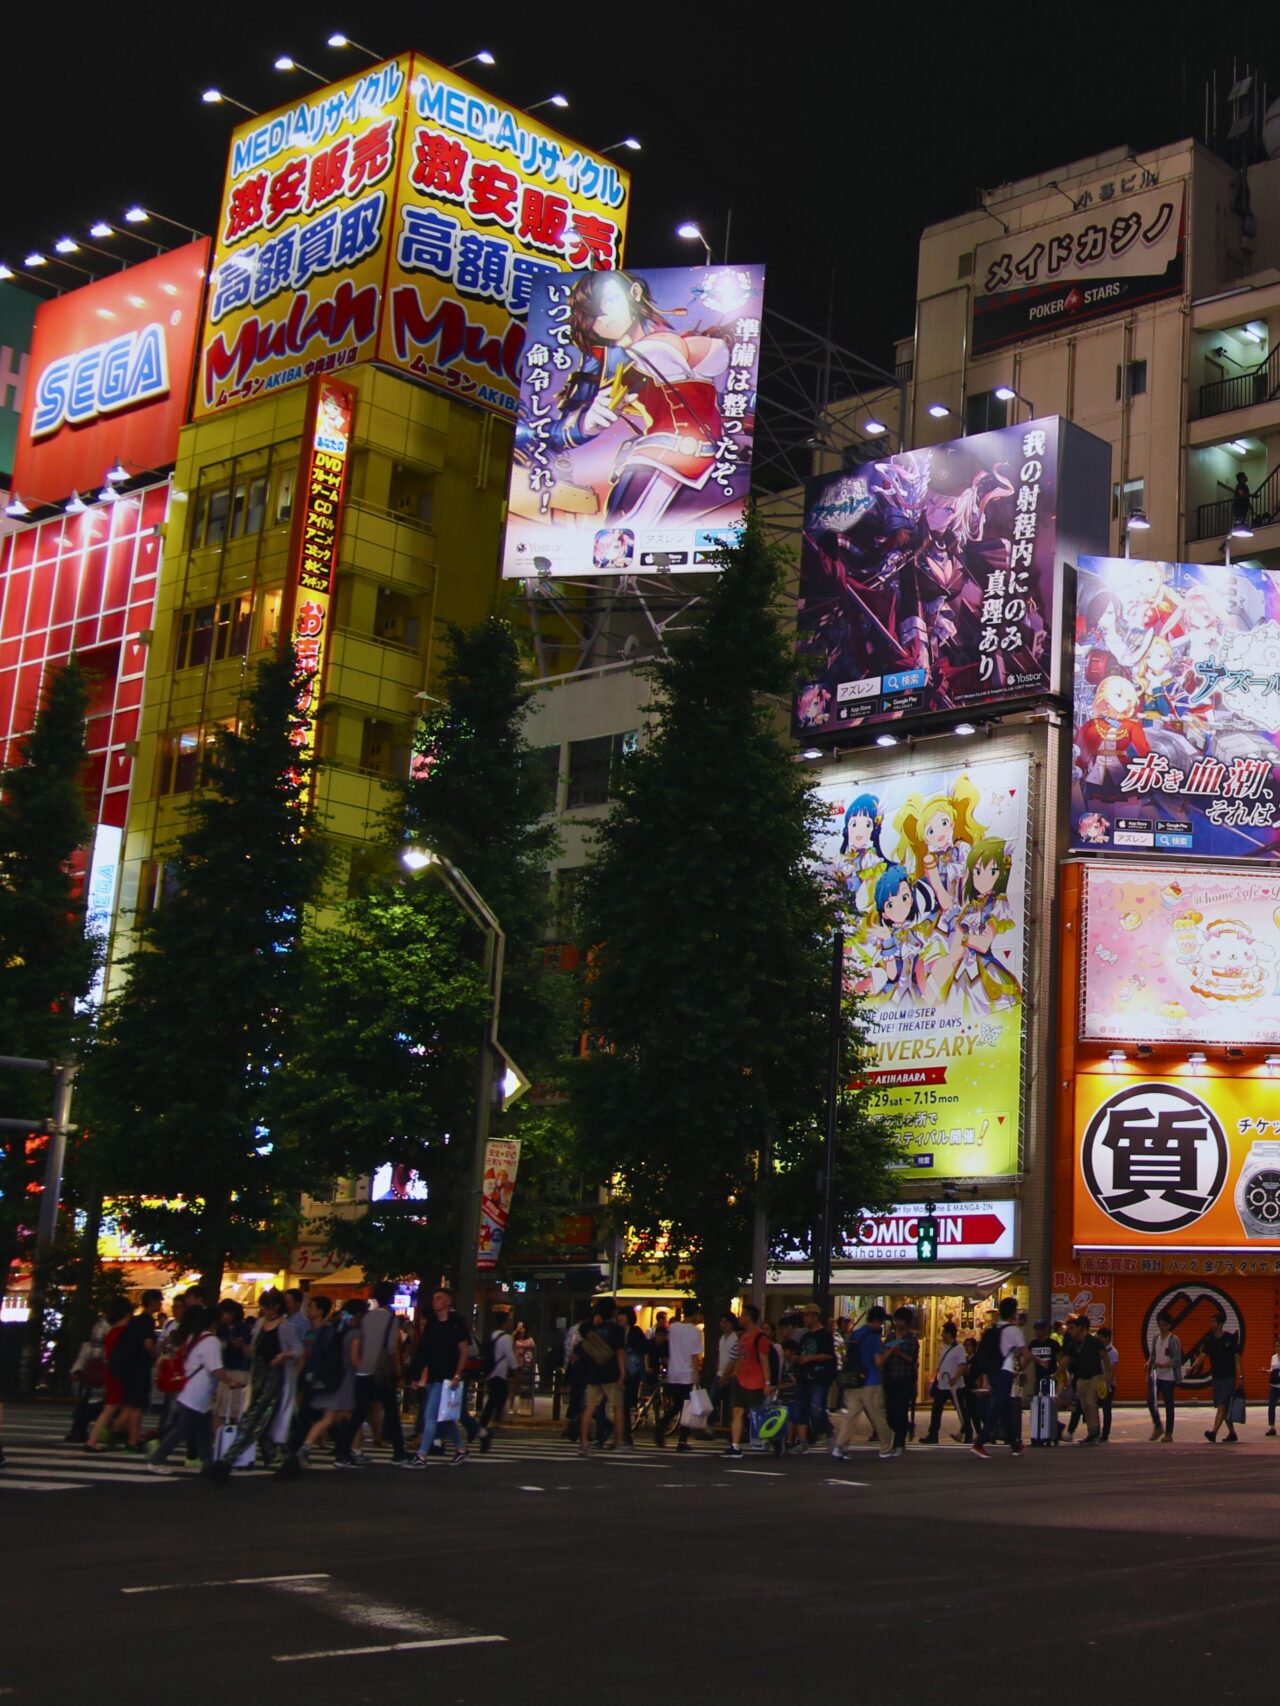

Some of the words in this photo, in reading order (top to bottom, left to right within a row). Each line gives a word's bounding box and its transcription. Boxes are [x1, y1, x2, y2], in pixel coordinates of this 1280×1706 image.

[224, 117, 394, 244] 激安販売
[411, 128, 617, 272] 激安販売
[211, 191, 385, 321] 高額買取
[397, 205, 533, 311] 高額買
[984, 202, 1175, 294] メイドカジノ
[1029, 299, 1065, 322] POKER
[1084, 281, 1121, 305] STARS
[202, 279, 381, 406] Mulan
[392, 283, 528, 389] Mul
[547, 284, 572, 370] いつでも
[30, 322, 171, 438] SEGA
[215, 378, 265, 408] ムーラン
[264, 365, 302, 390] AKIBA
[409, 354, 478, 394] ムーラン
[712, 318, 759, 497] 準備は整ったぞ。
[315, 453, 343, 473] DVD
[311, 482, 339, 502] ゲーム
[313, 498, 333, 515] CD
[304, 526, 335, 546] アニメ
[307, 511, 335, 531] アイドル
[1000, 429, 1047, 651] 我の射程内にのみ
[979, 569, 1007, 682] 真理あり
[839, 683, 875, 698] アズレン
[1016, 671, 1043, 684] Yostar
[1116, 833, 1148, 843] アズレン
[879, 1007, 937, 1020] IDOLM@STER
[898, 1020, 937, 1032] THEATER
[938, 1018, 963, 1029] DAYS
[874, 1072, 926, 1085] AKIHABARA
[1096, 1105, 1214, 1215] 質
[848, 1247, 907, 1258] kihabara
[1082, 1258, 1137, 1273] 高価買取
